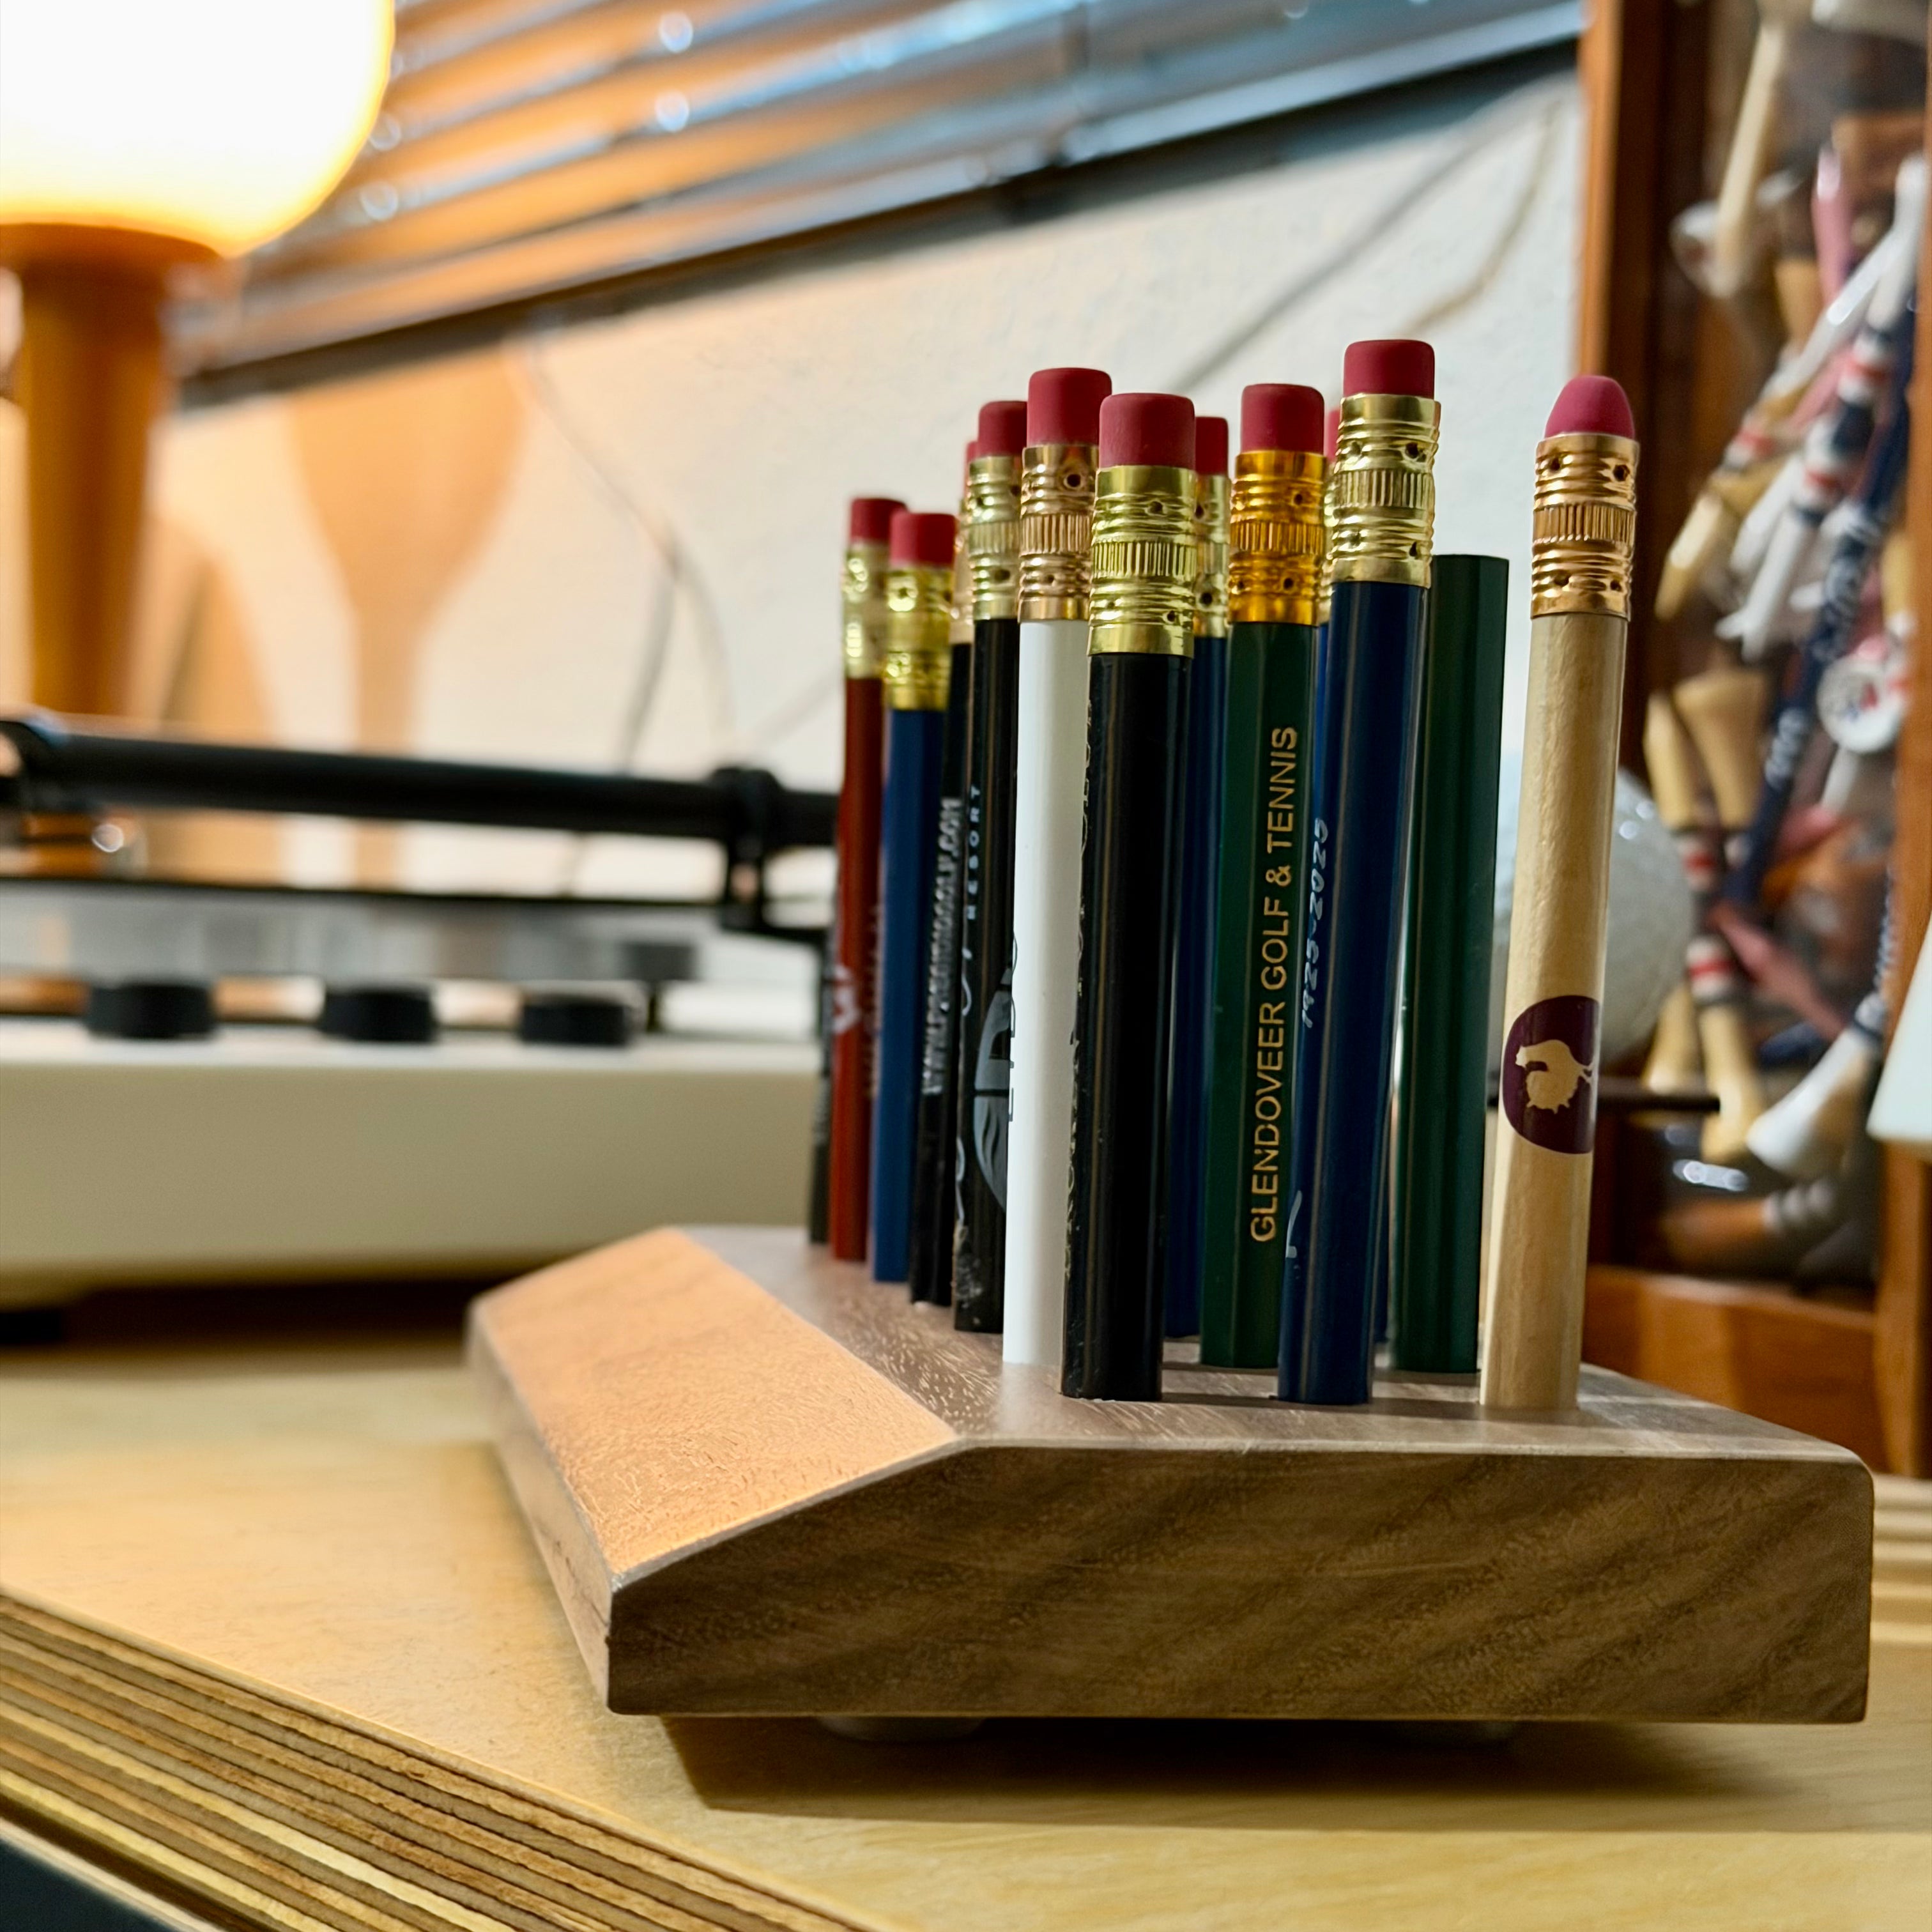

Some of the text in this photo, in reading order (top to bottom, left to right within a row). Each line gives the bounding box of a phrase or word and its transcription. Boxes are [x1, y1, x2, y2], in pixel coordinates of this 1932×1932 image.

[1249, 727, 1298, 1243] GLENDOVEER GOLF & TENNIS
[1301, 817, 1329, 1029] 1925-2025
